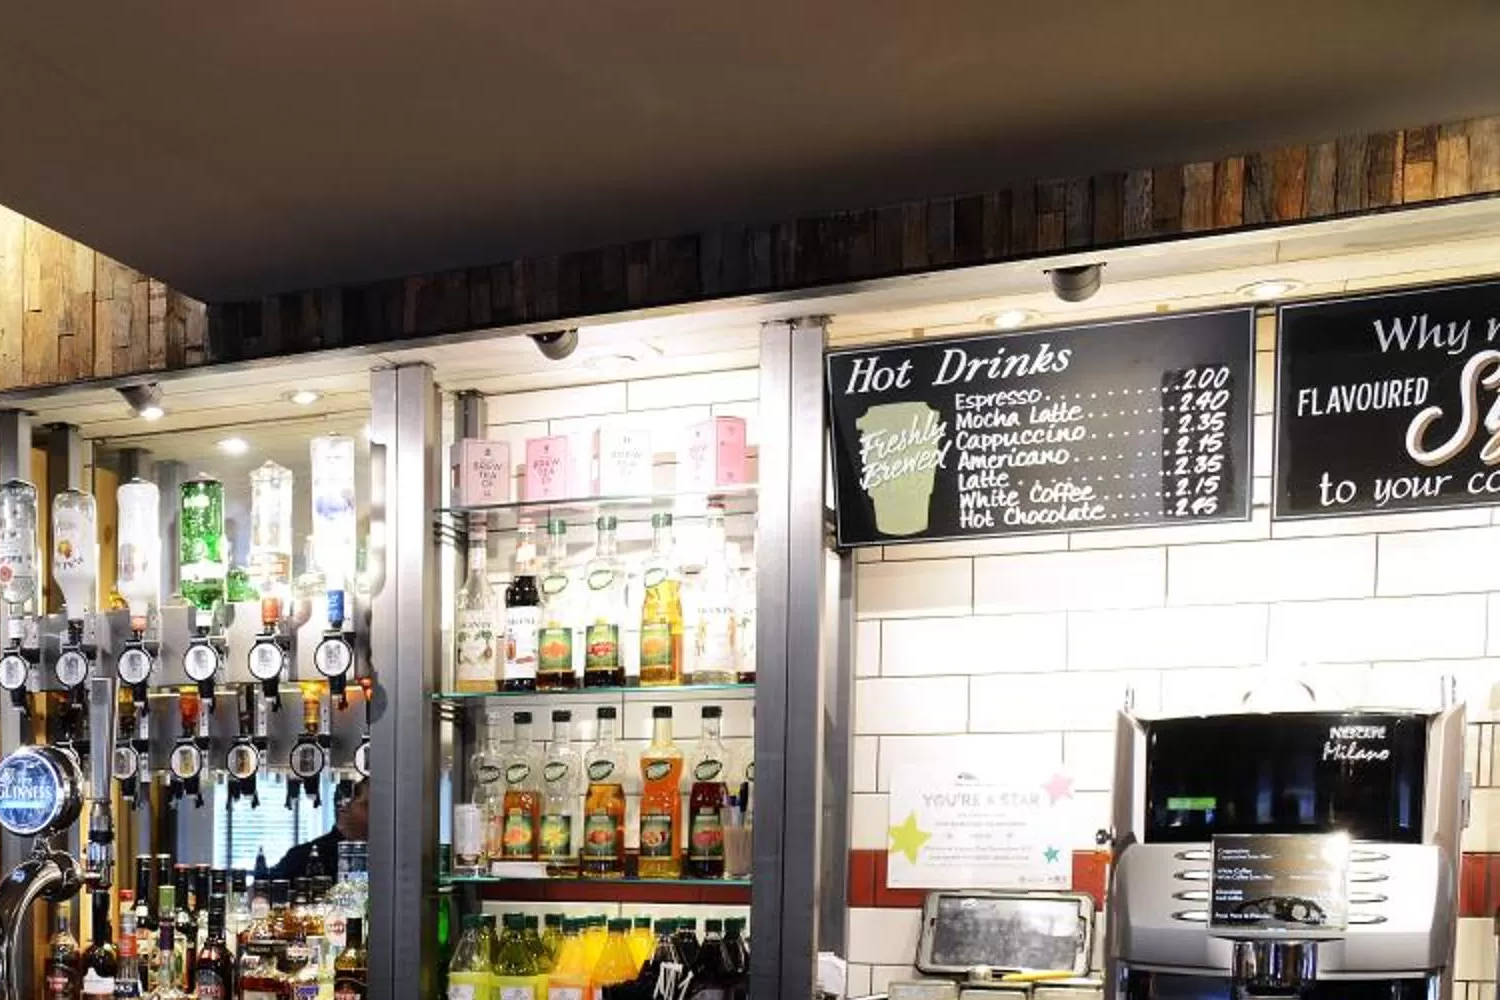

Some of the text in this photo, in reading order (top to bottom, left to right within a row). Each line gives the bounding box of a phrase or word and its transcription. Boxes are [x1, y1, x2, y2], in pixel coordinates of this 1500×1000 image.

[1373, 313, 1472, 355] Why
[845, 343, 1073, 394] Hot Drinks
[955, 389, 1042, 411] Espresso
[955, 390, 1230, 431] Mocha Latte 2.40
[1297, 376, 1429, 417] FLAVOURED
[859, 411, 948, 465] Freshly
[955, 411, 1227, 452] Cappuccino 2.35
[859, 439, 953, 491] Brewed
[957, 448, 1070, 471] Americano
[958, 454, 1225, 492] Latte 2.35
[959, 475, 1222, 509] White Coffee 2.15
[1319, 471, 1358, 507] to
[1374, 474, 1454, 508] your
[959, 509, 995, 529] Hot
[1003, 501, 1107, 526] Chocolate
[1323, 741, 1391, 762] Milano
